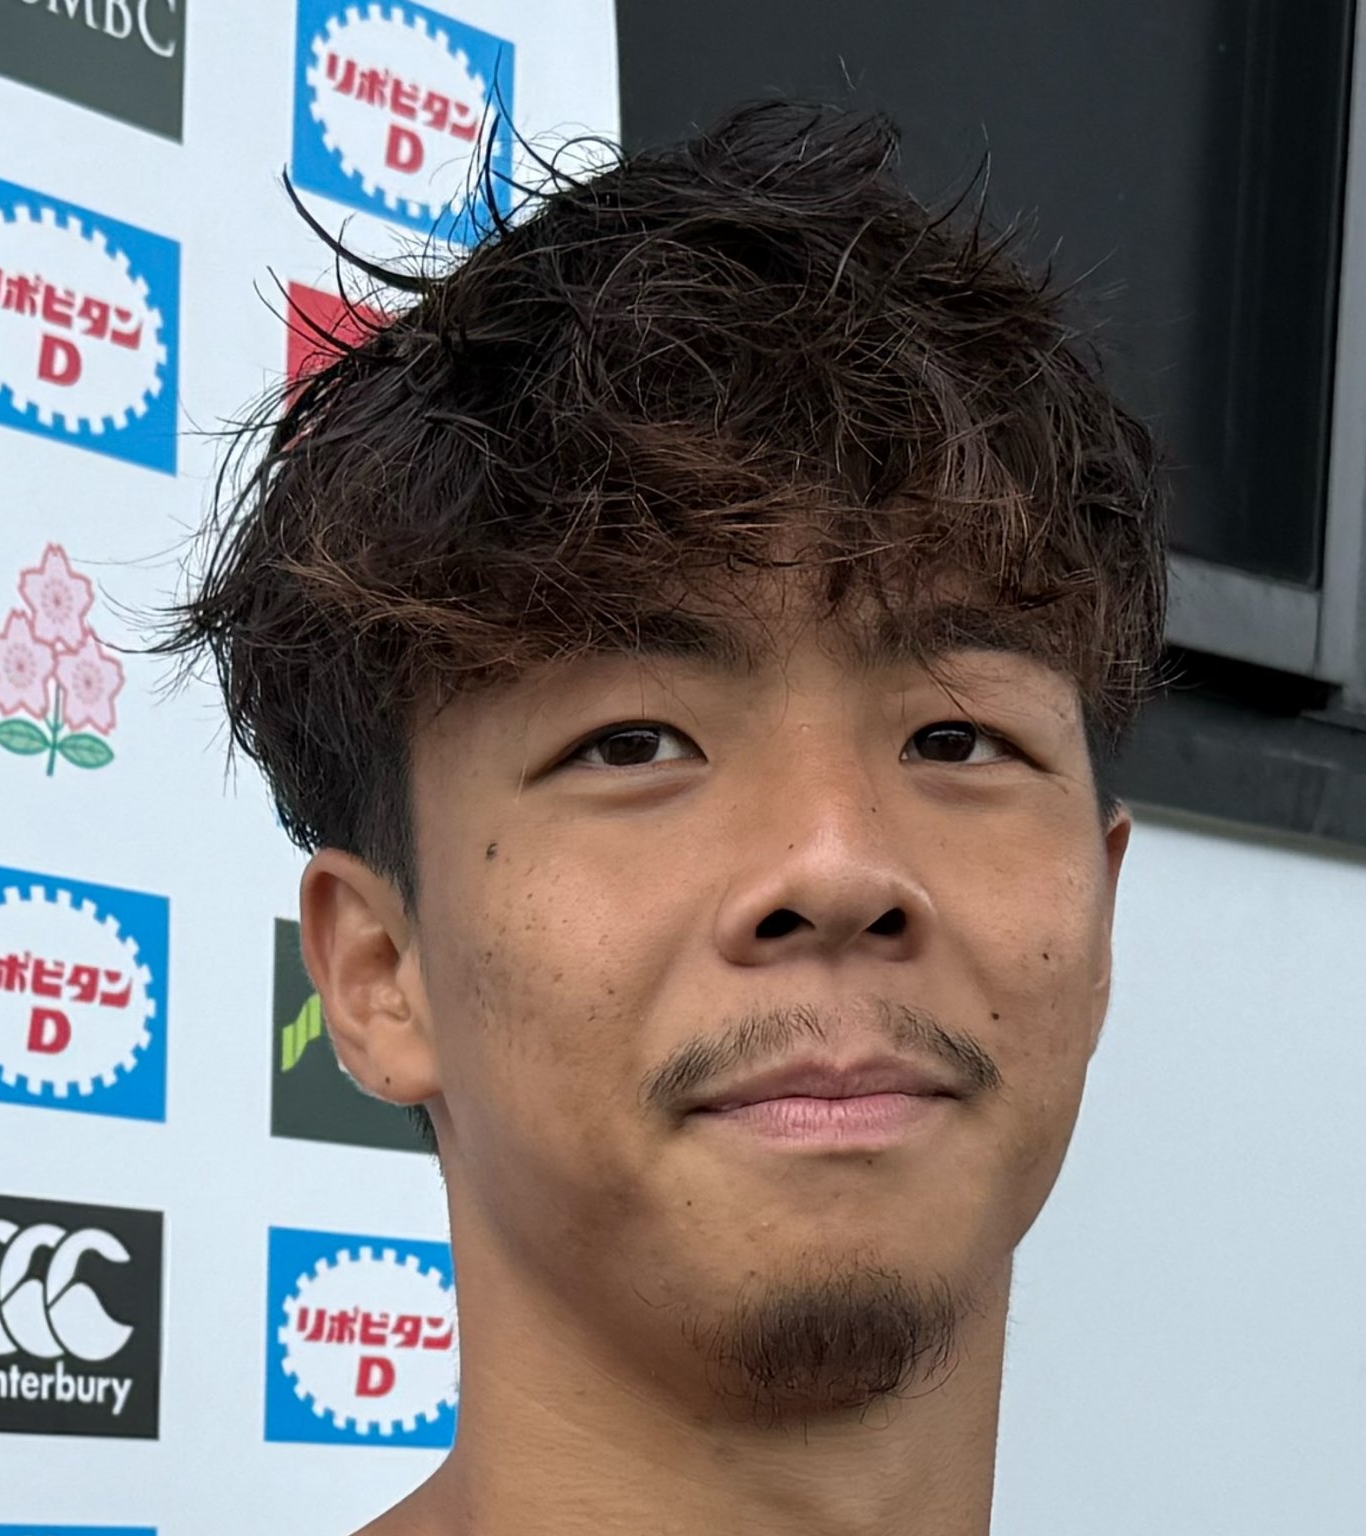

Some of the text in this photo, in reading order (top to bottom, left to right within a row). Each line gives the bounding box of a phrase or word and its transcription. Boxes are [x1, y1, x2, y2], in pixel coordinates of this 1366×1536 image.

[325, 52, 481, 143] リポビタン
[384, 123, 425, 174] D
[36, 333, 82, 386] D
[26, 1005, 72, 1056] D
[296, 1303, 455, 1352] リポビタン
[354, 1355, 397, 1399] D
